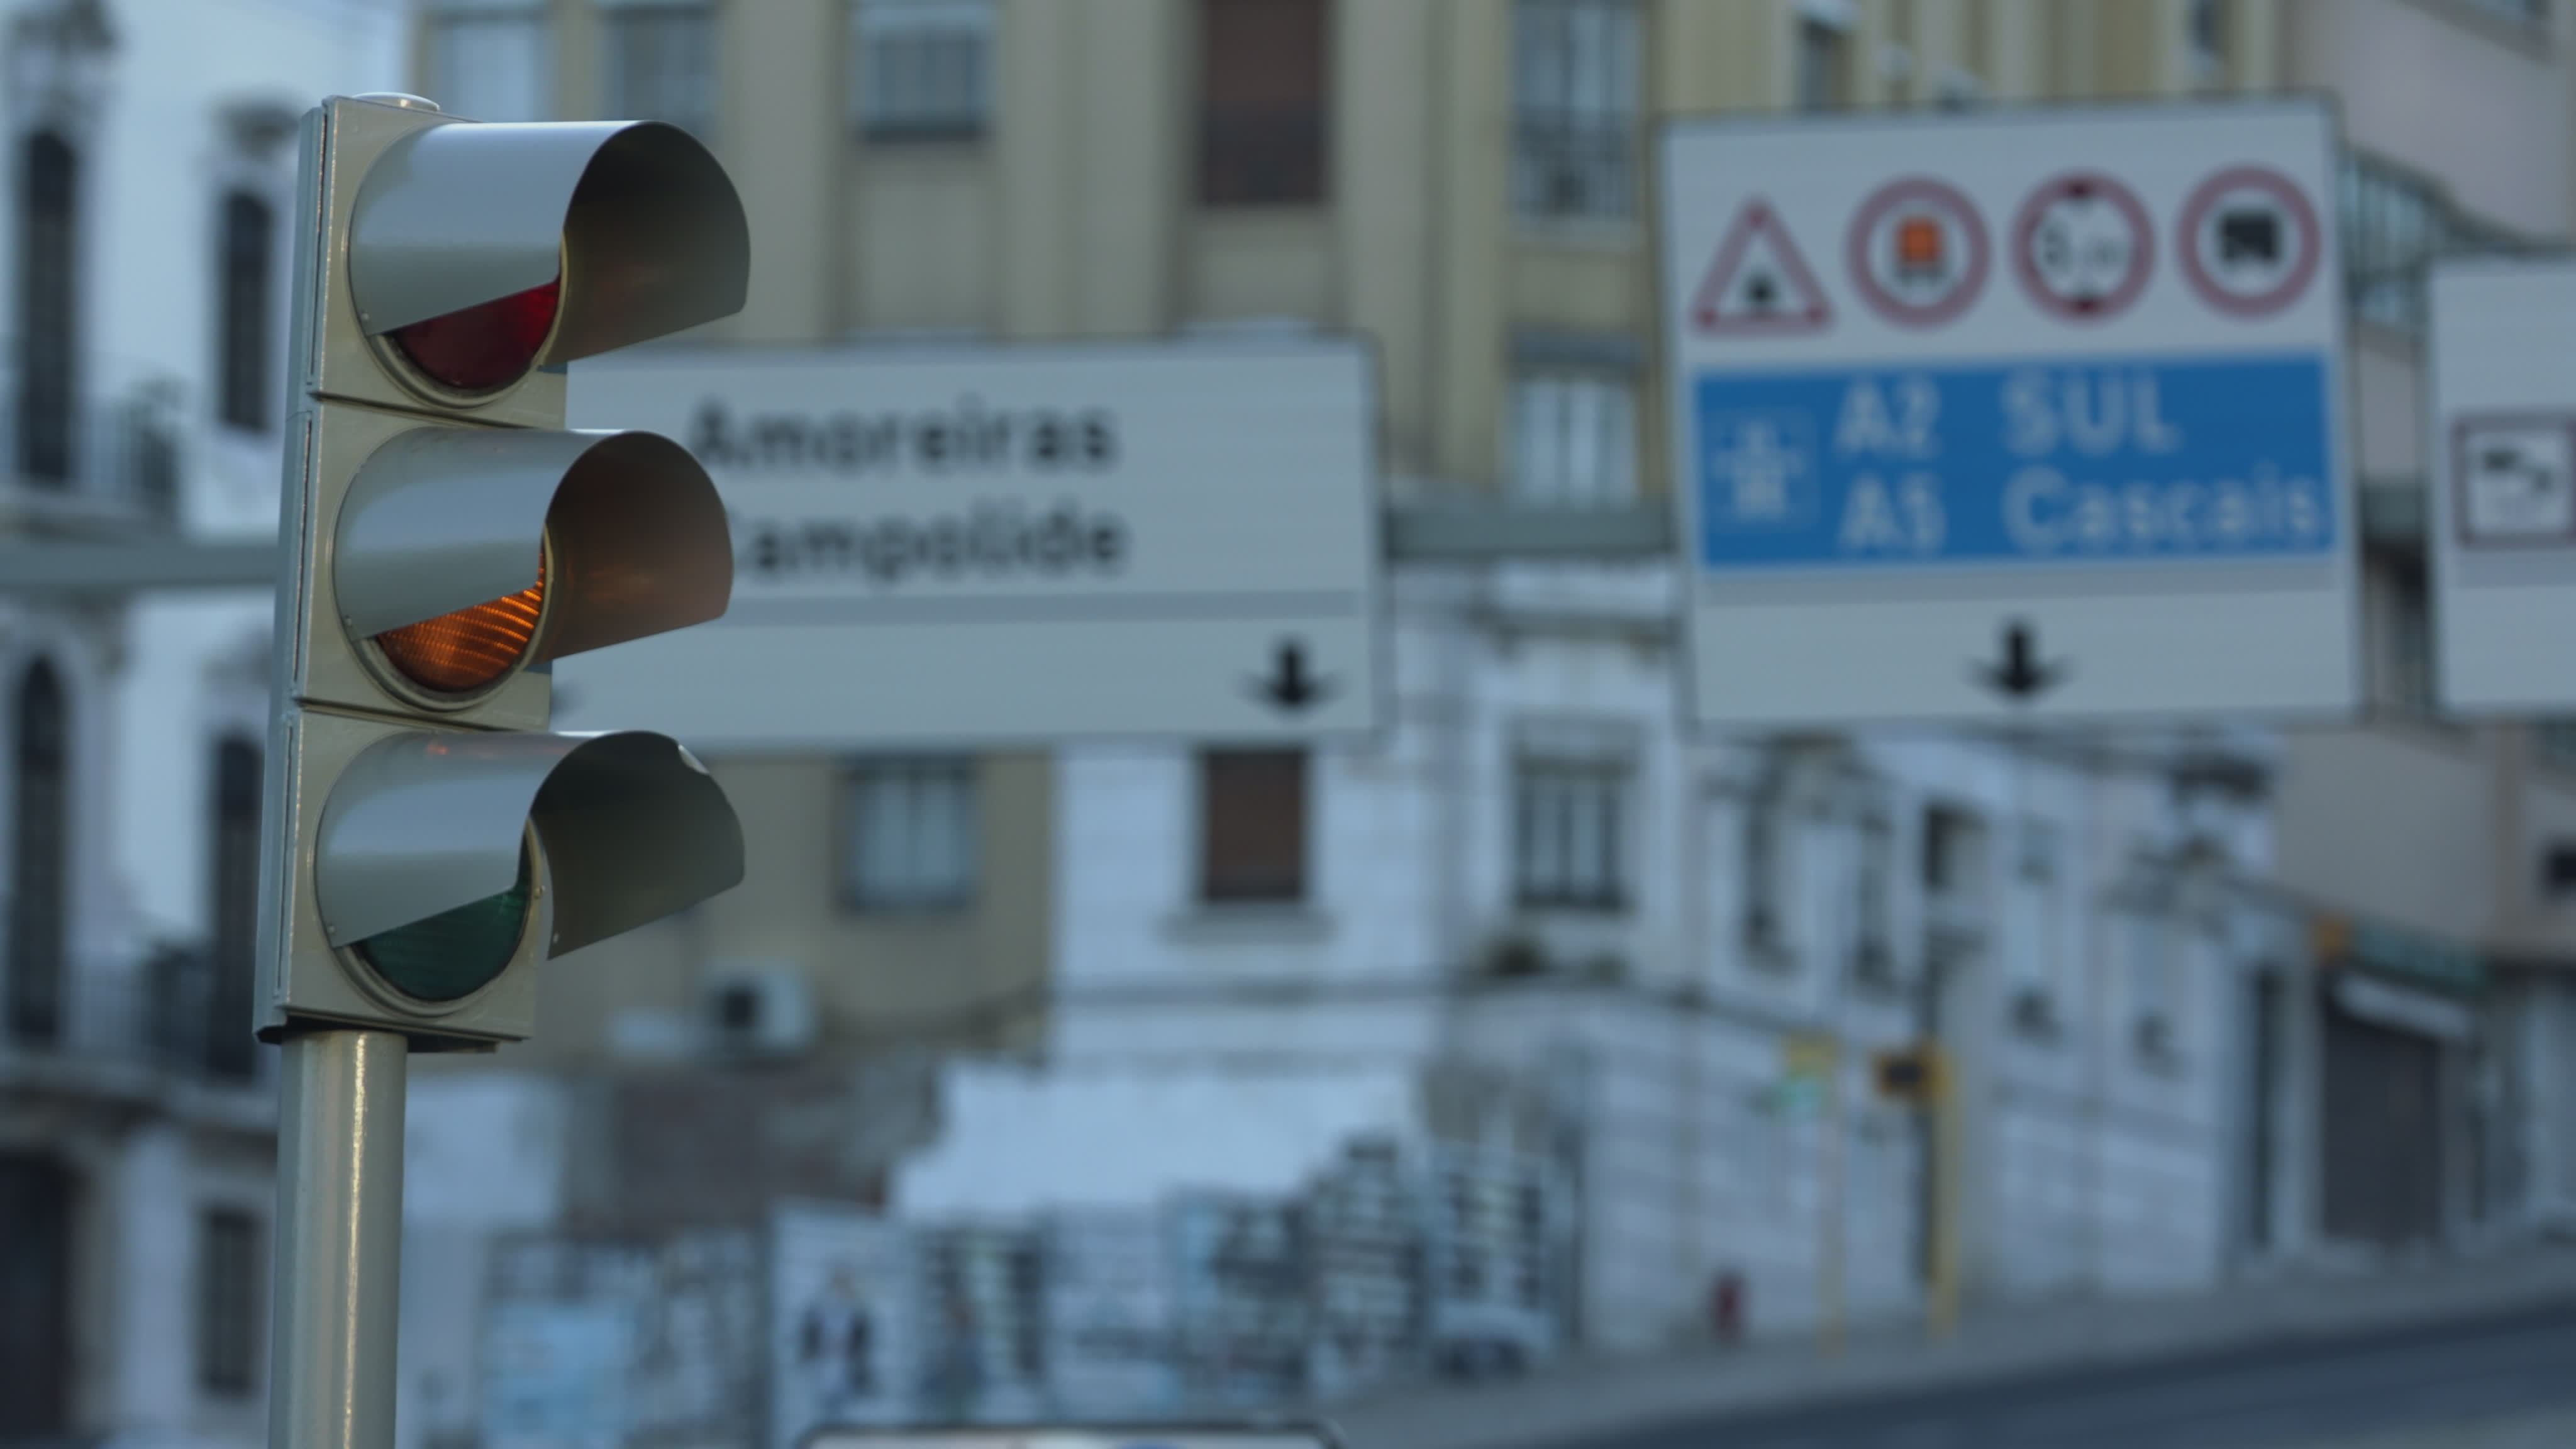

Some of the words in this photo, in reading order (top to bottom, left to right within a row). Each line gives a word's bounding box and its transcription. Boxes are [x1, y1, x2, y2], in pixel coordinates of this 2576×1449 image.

[693, 395, 1119, 473] Amoreiras
[1835, 375, 1942, 459] A2
[2000, 365, 2184, 457] SUL
[730, 496, 1130, 582] ampolide
[2001, 460, 2328, 552] Cascais
